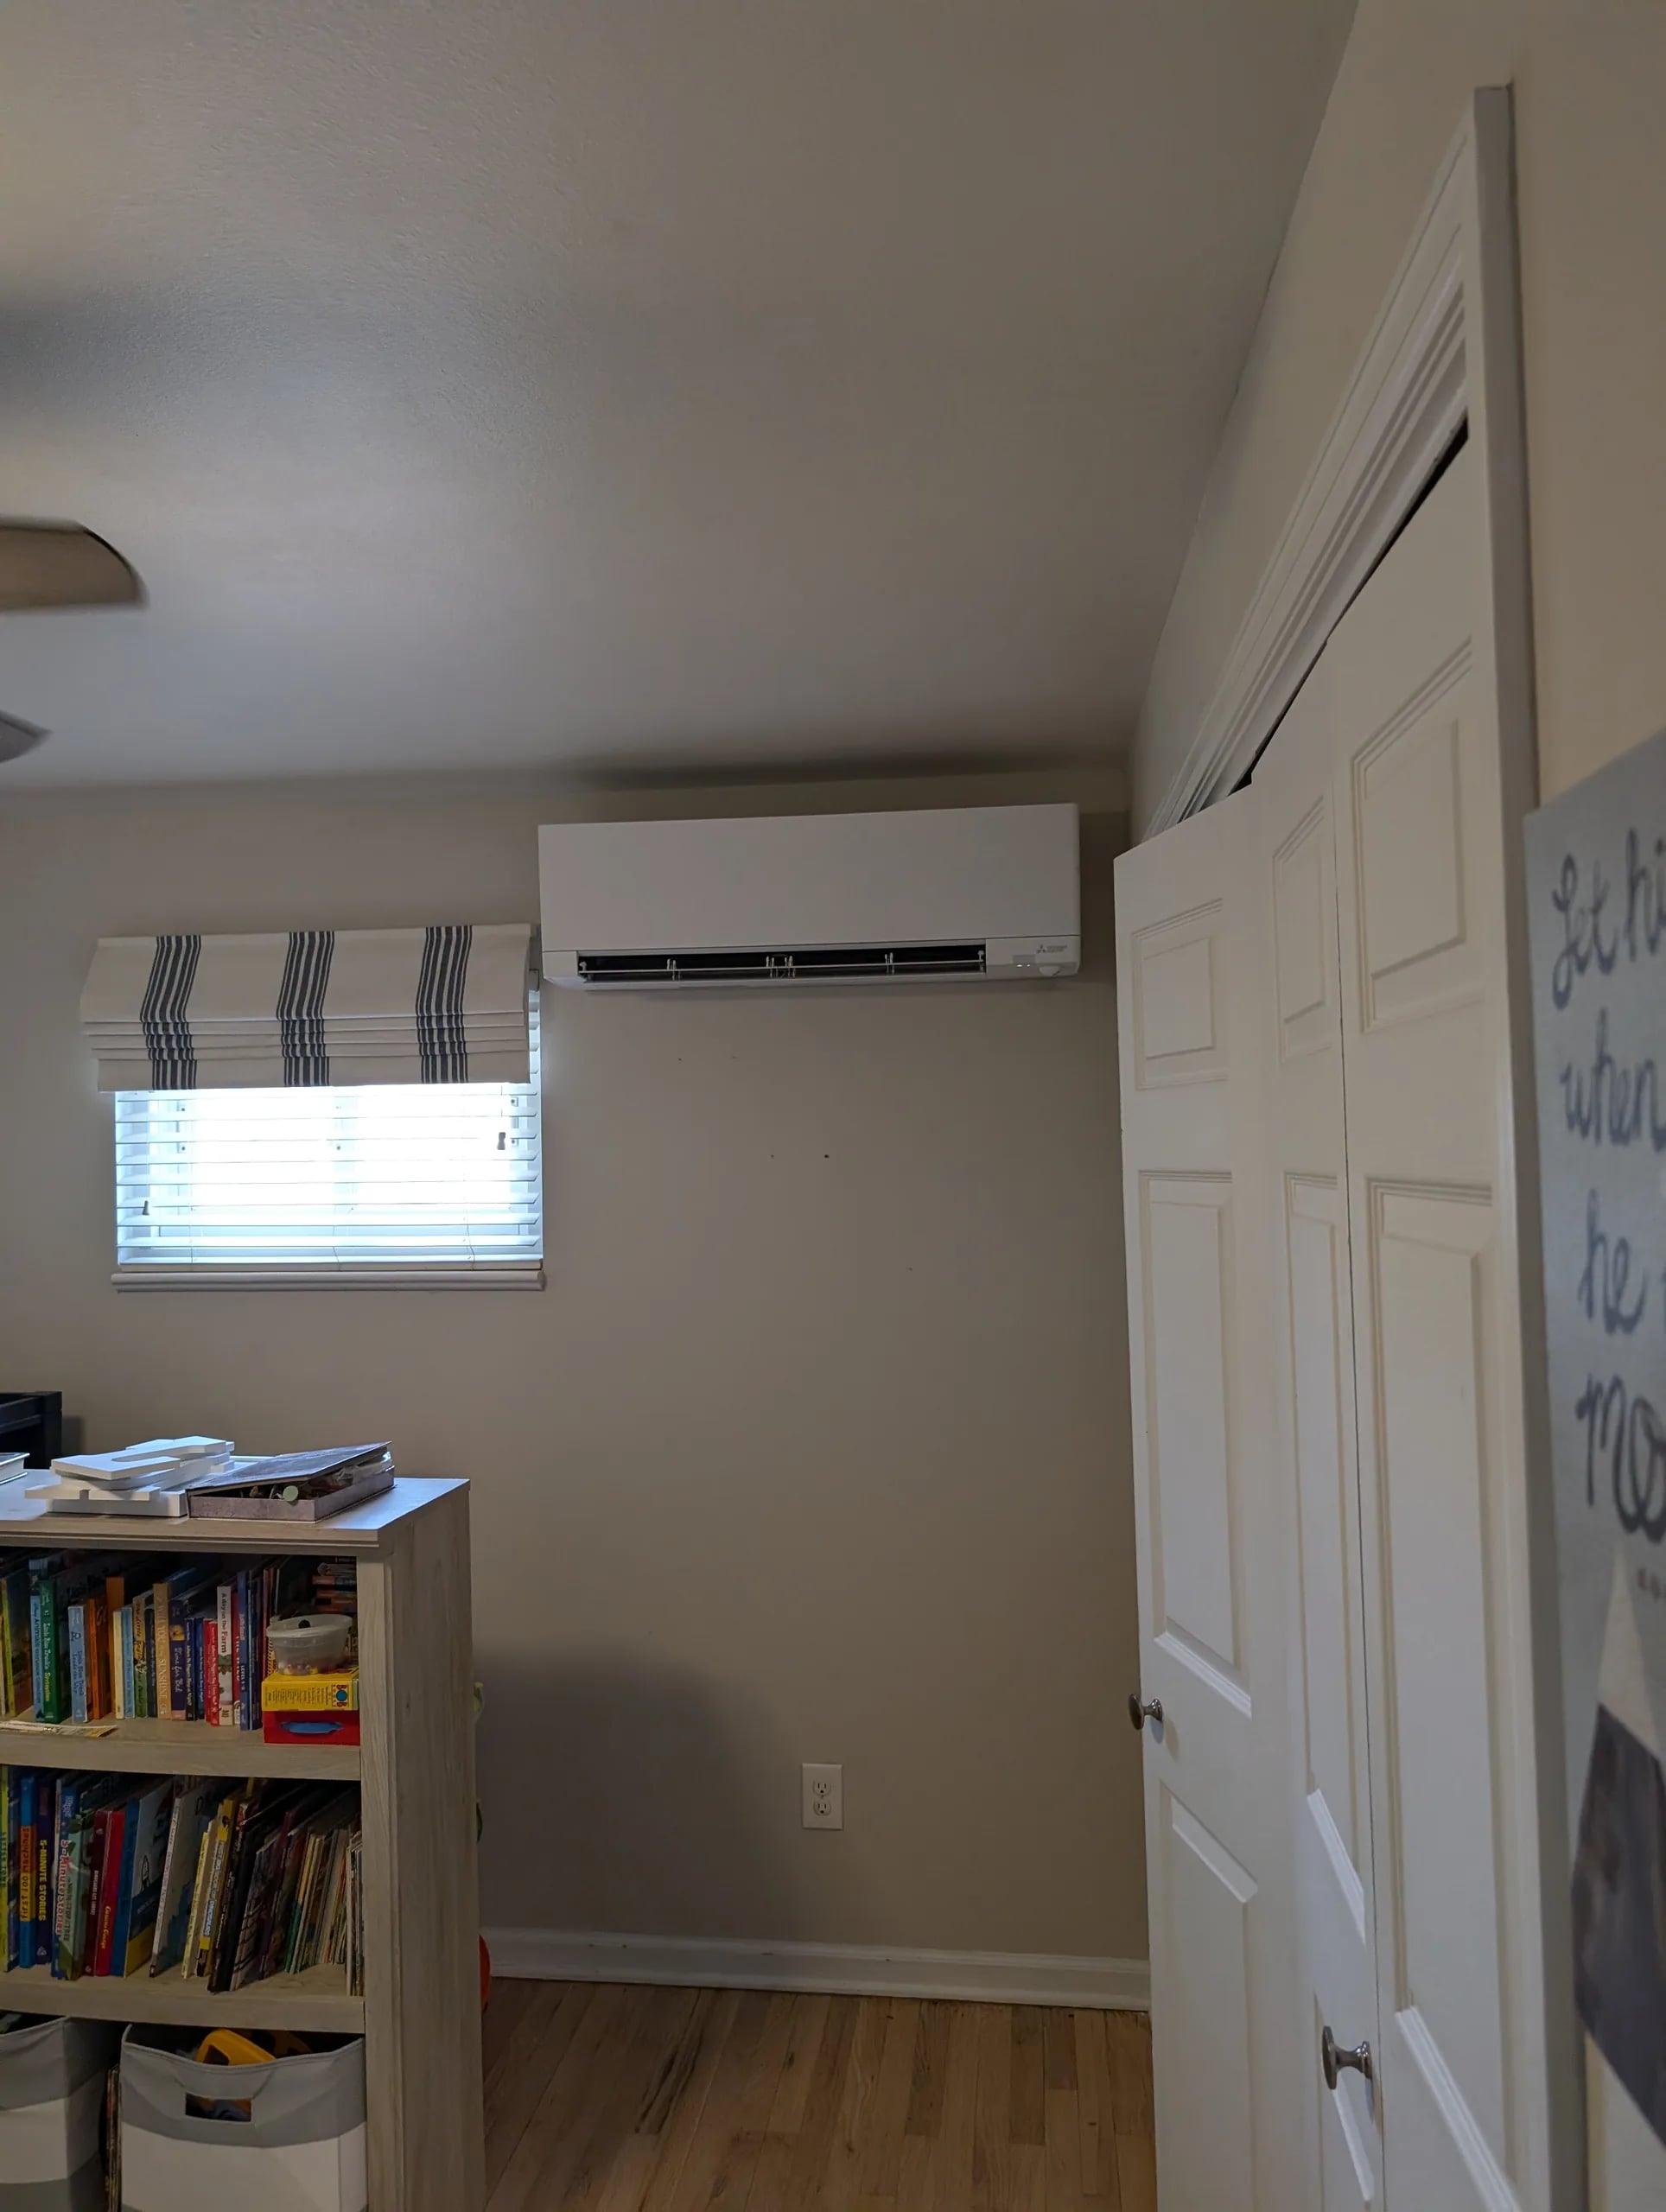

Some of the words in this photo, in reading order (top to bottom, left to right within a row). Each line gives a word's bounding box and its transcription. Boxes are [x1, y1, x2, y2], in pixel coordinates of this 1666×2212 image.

[1552, 852, 1619, 1010] Let
[1625, 826, 1666, 963] hi
[1577, 1187, 1649, 1336] he
[156, 1626, 167, 1643] YOU
[39, 1839, 48, 1882] 5-MINUTE
[21, 1875, 29, 1892] 100
[20, 1895, 29, 1920] first
[38, 1884, 47, 1922] STORIES
